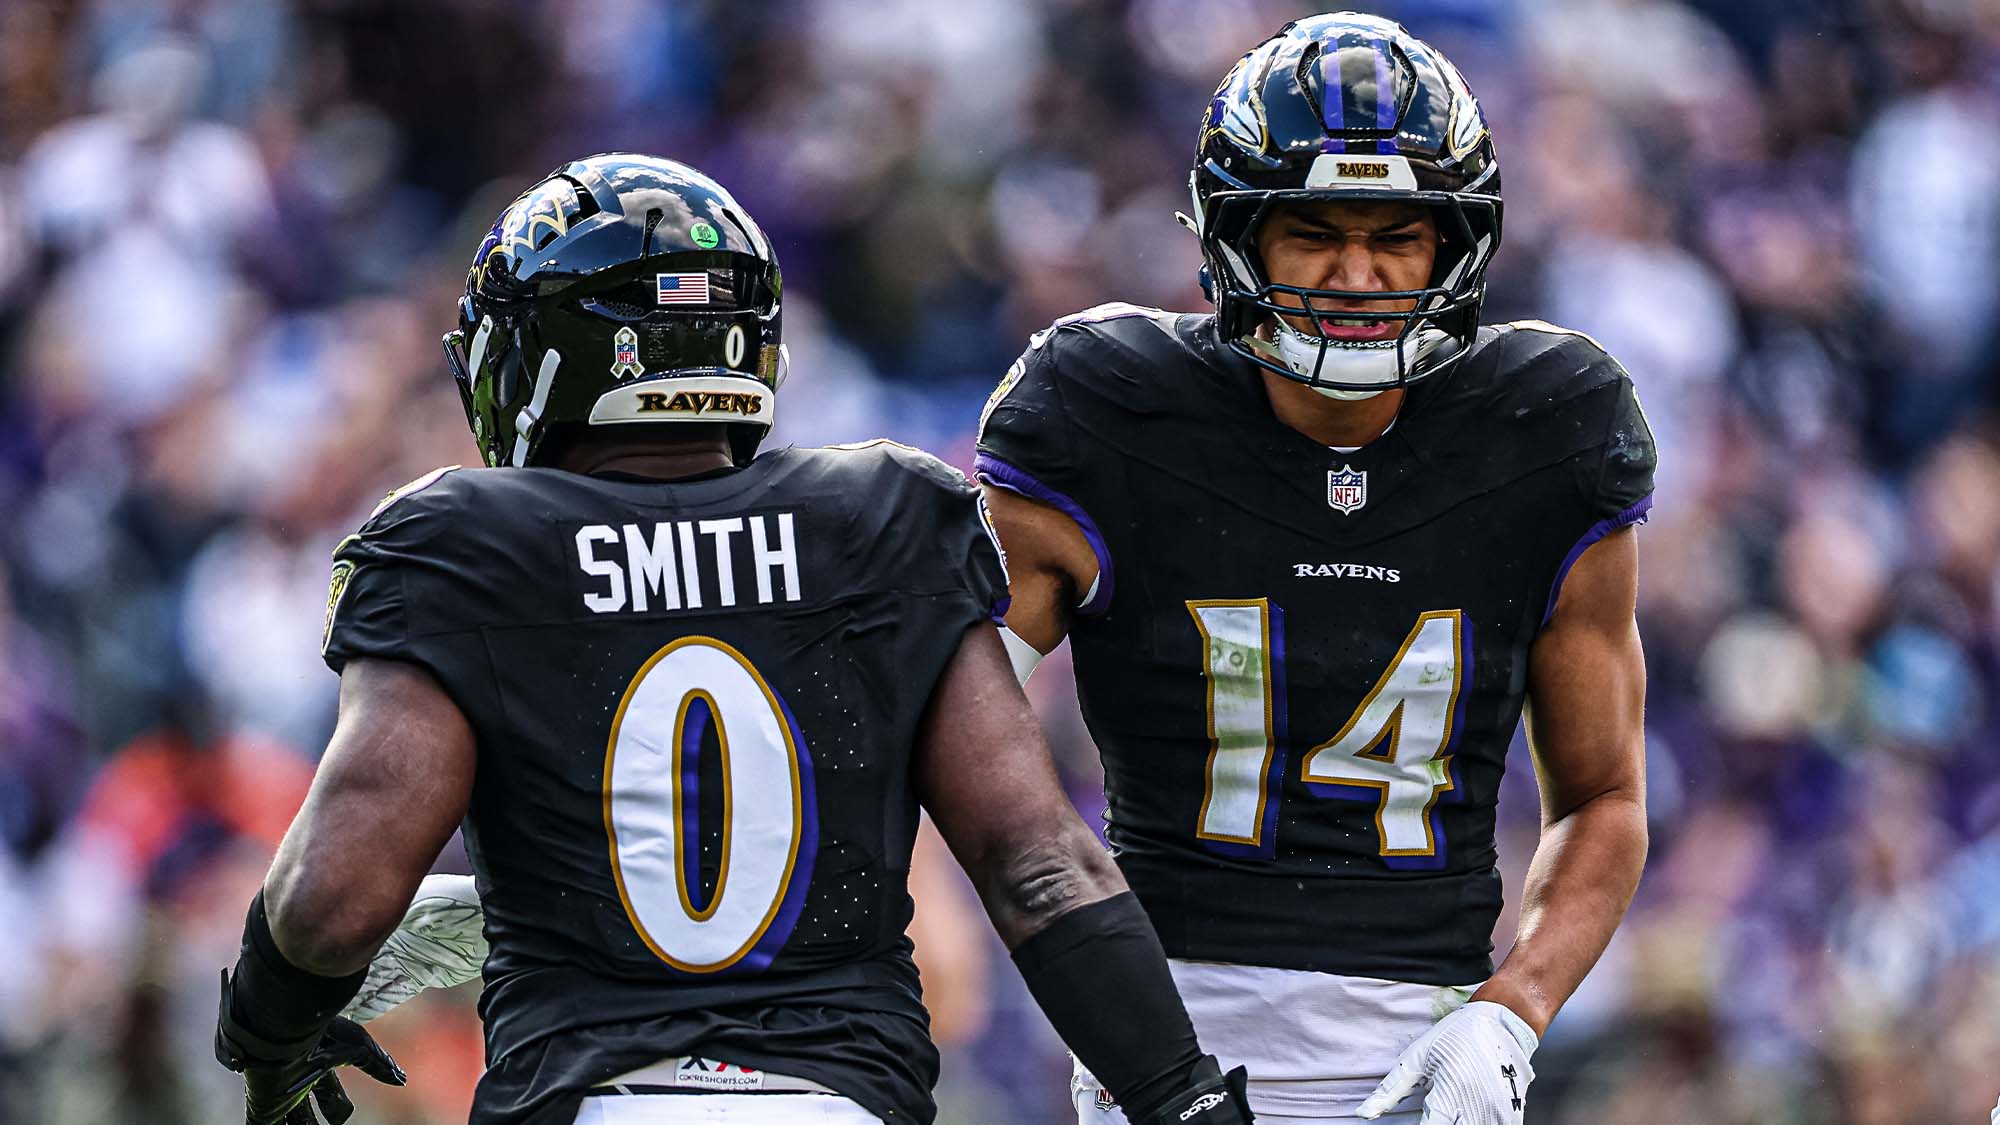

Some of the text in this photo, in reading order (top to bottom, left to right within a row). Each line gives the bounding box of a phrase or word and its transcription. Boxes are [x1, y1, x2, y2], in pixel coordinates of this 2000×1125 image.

[1336, 162, 1389, 178] RAVENS
[619, 352, 634, 363] NFL
[725, 324, 745, 368] 0
[636, 391, 763, 416] RAVENS
[1333, 487, 1360, 505] NFL
[575, 513, 801, 613] SMITH
[1293, 563, 1400, 582] RAVENS
[1185, 597, 1468, 862] 14
[603, 634, 808, 975] 0
